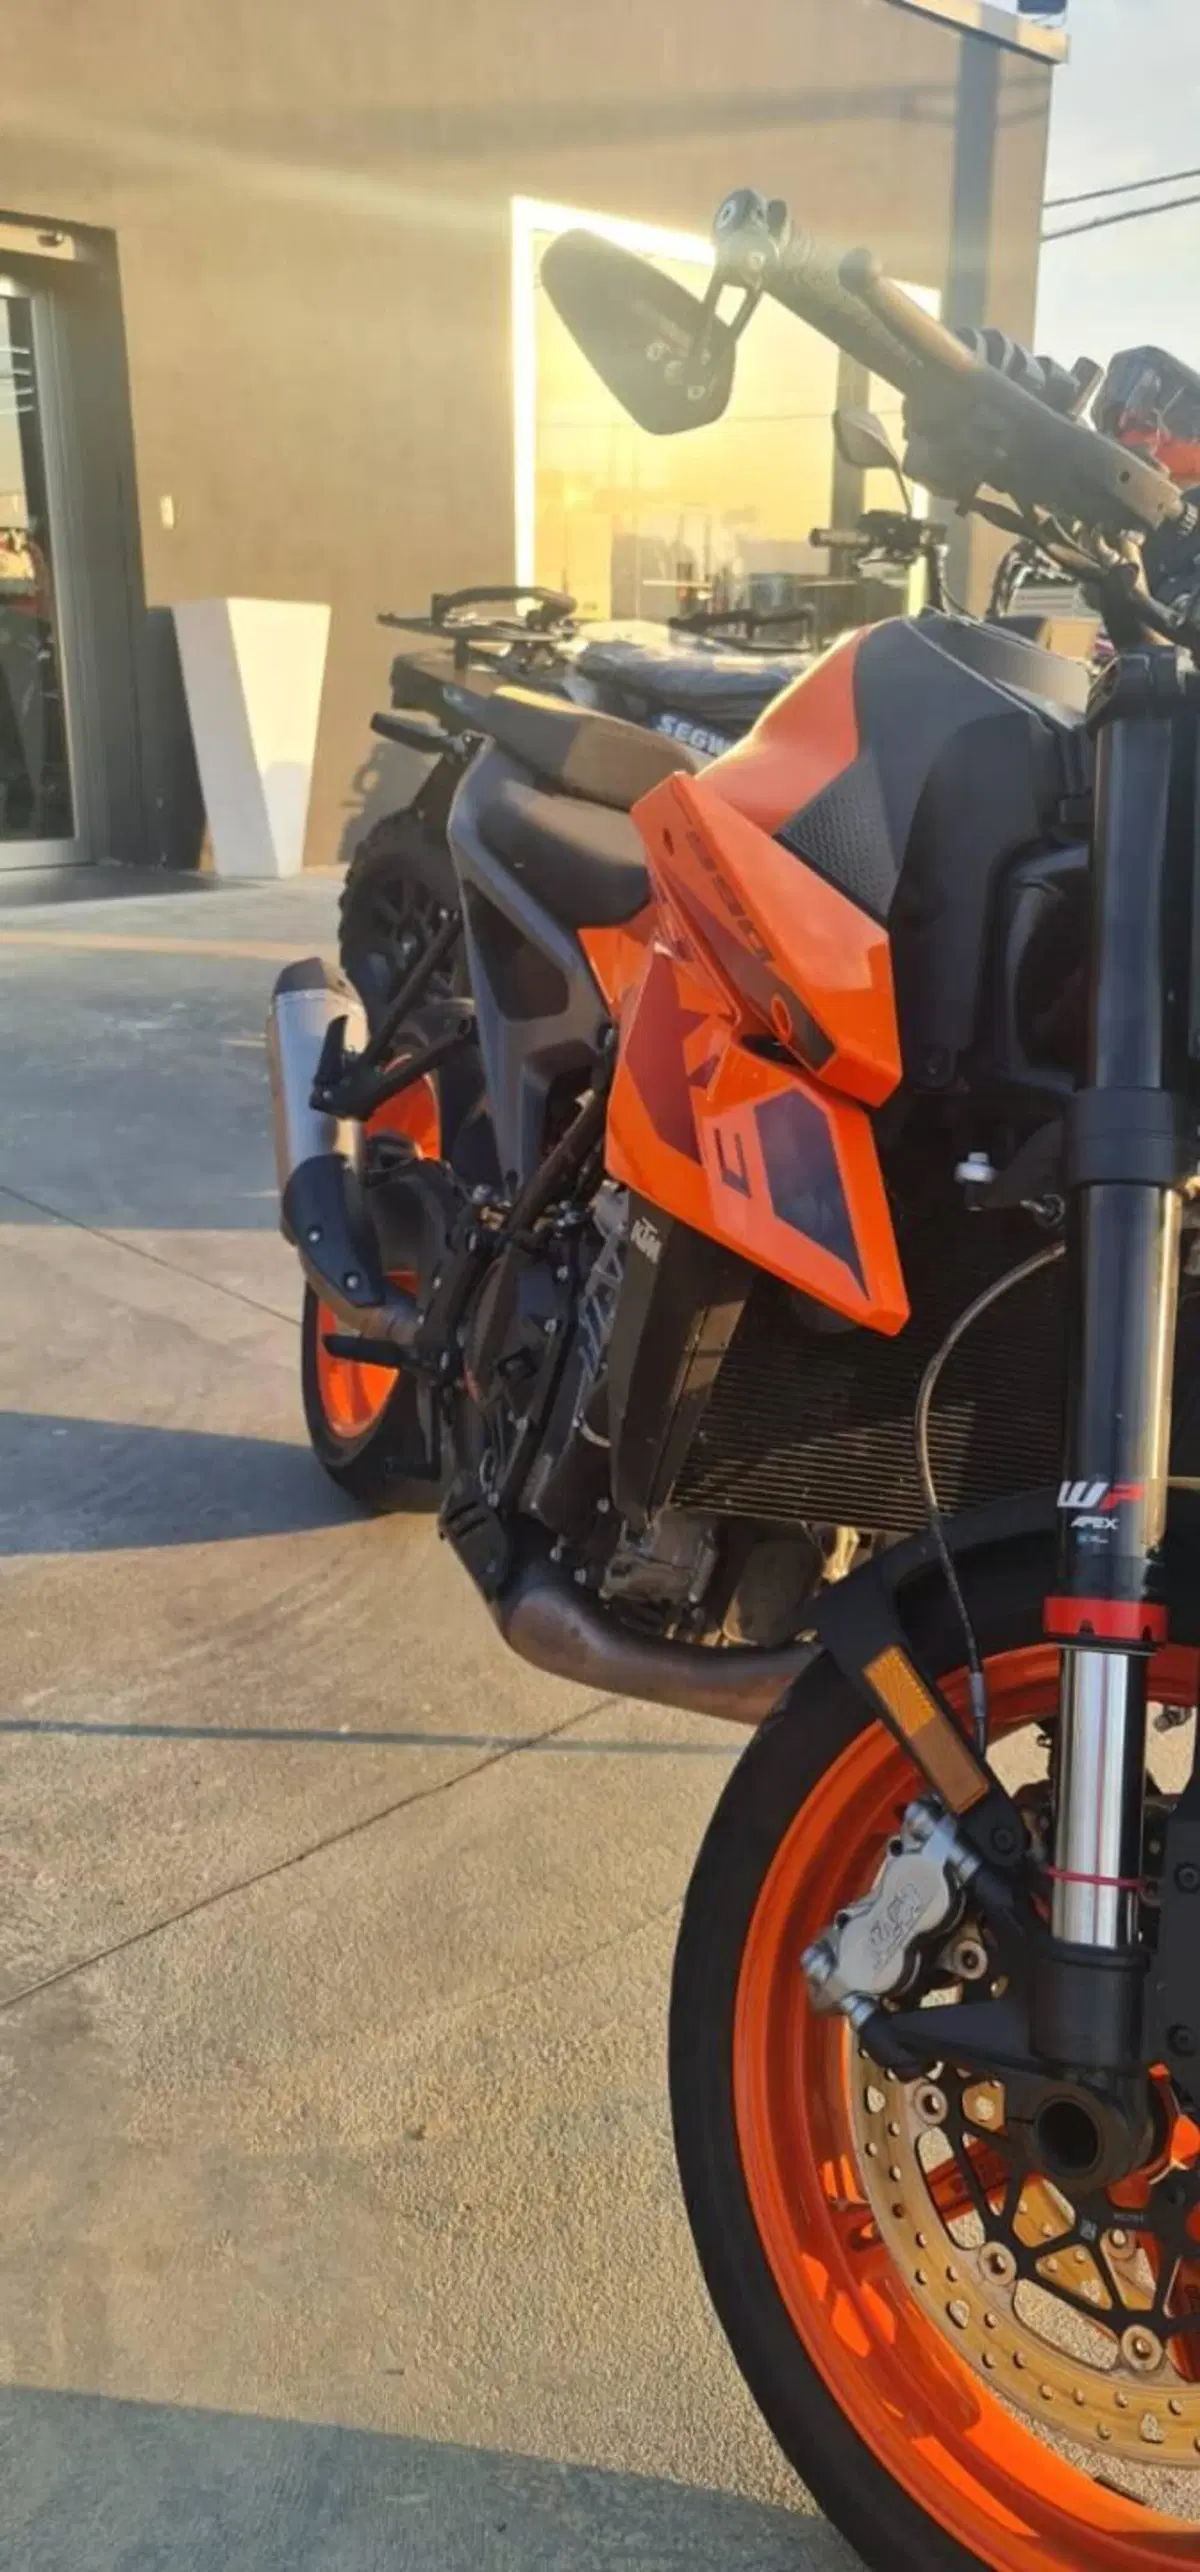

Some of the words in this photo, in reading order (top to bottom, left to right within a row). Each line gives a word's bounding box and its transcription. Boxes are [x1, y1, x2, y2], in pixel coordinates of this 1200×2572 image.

[630, 1216, 662, 1264] KTM
[1057, 1480, 1144, 1511] WP
[1070, 1515, 1118, 1530] APEX
